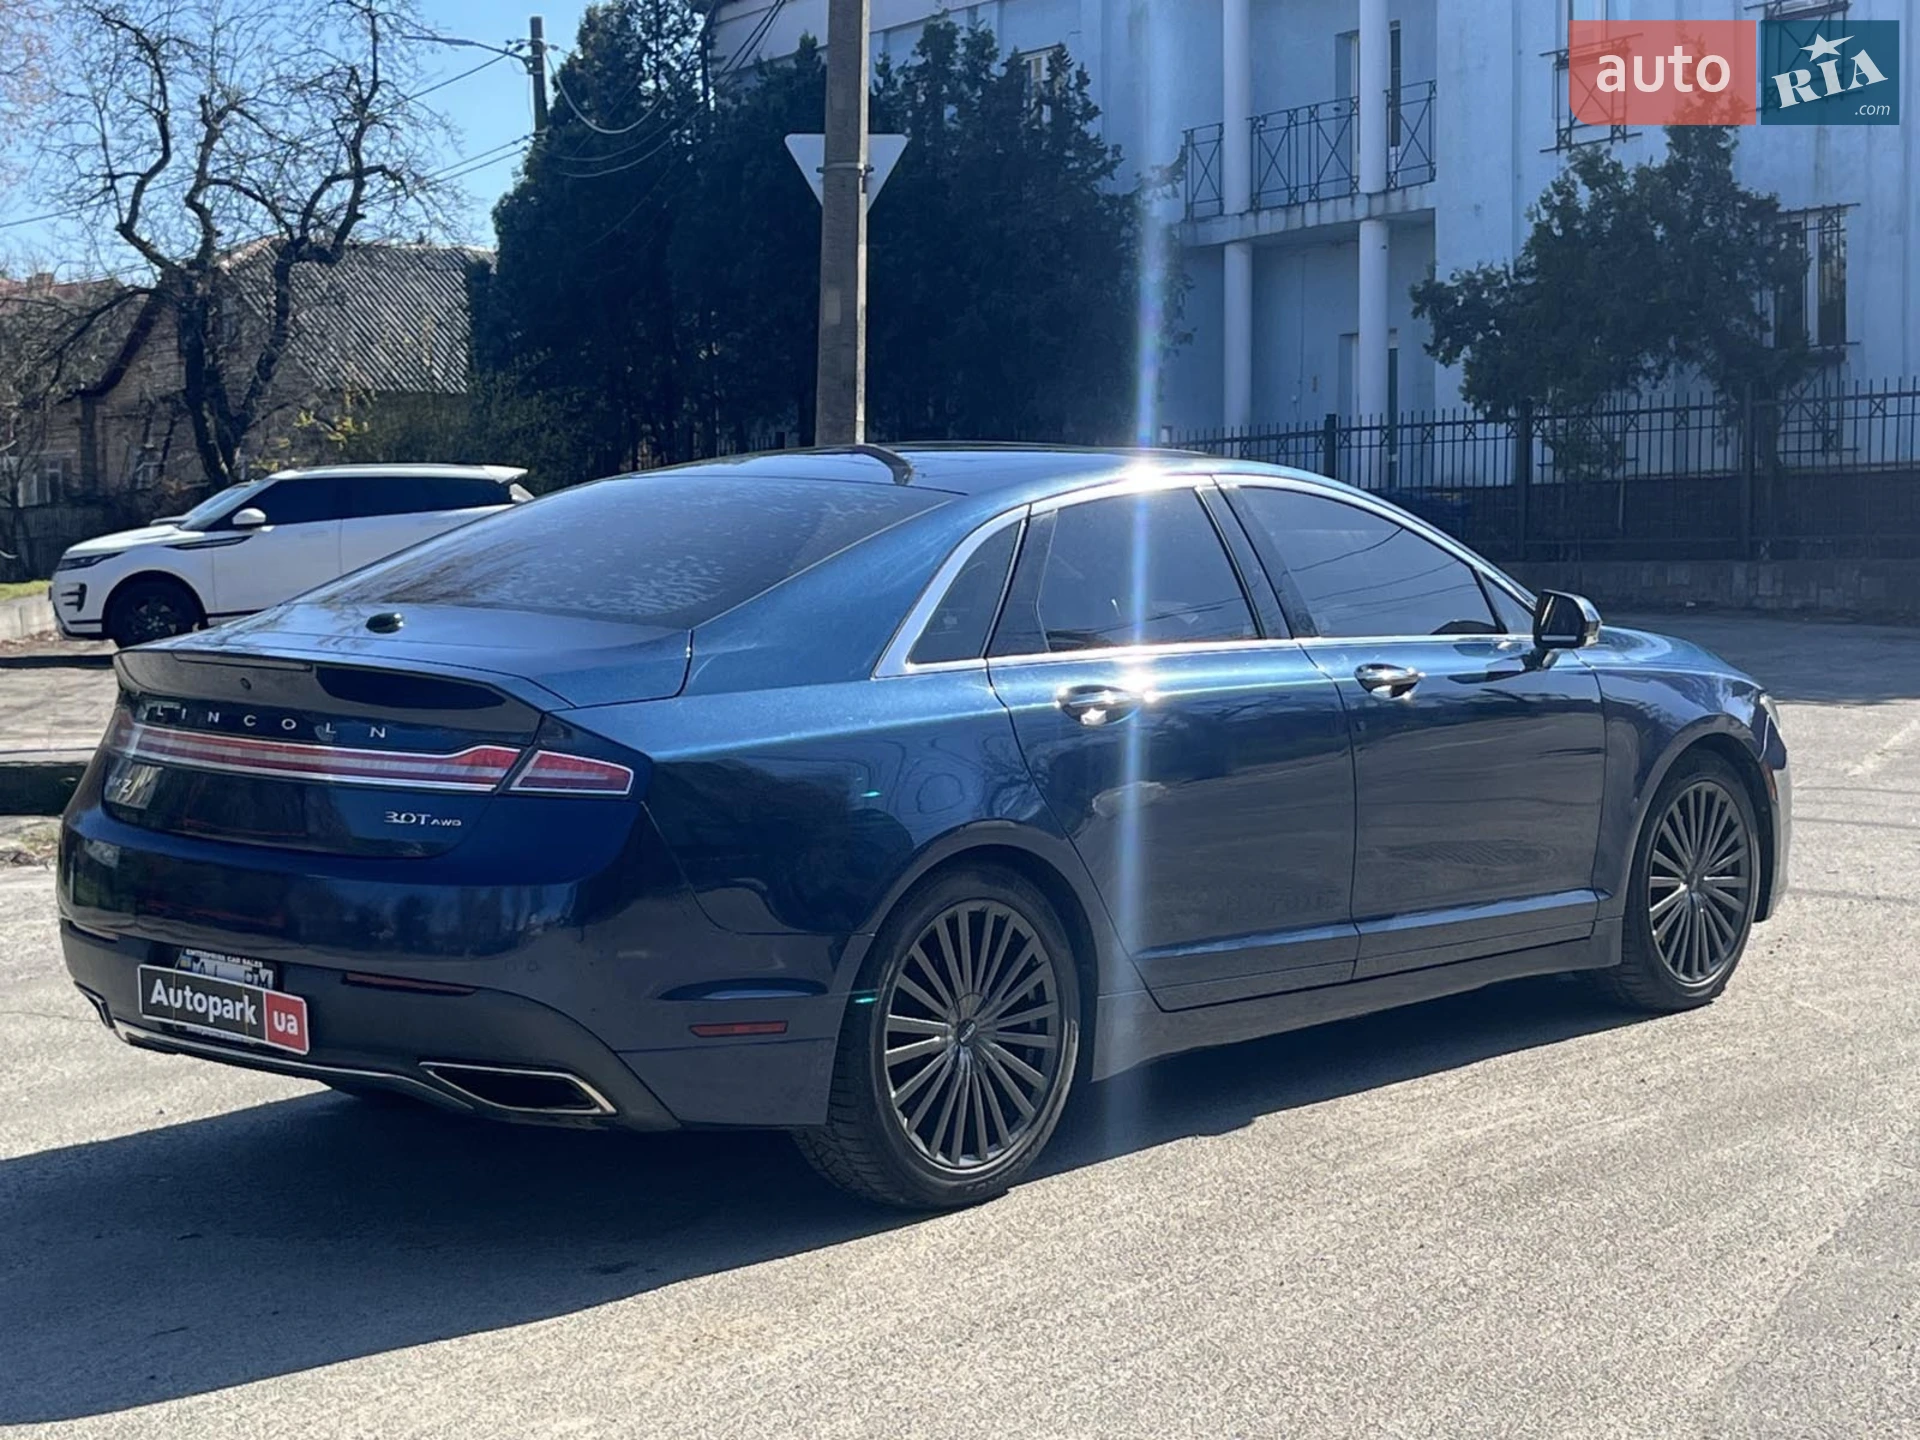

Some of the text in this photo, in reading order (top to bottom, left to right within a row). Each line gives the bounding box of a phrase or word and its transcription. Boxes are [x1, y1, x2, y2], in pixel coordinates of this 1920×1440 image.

[156, 705, 386, 738] LINCOLN
[151, 979, 258, 1025] Autopark
[273, 1010, 299, 1036] ua
